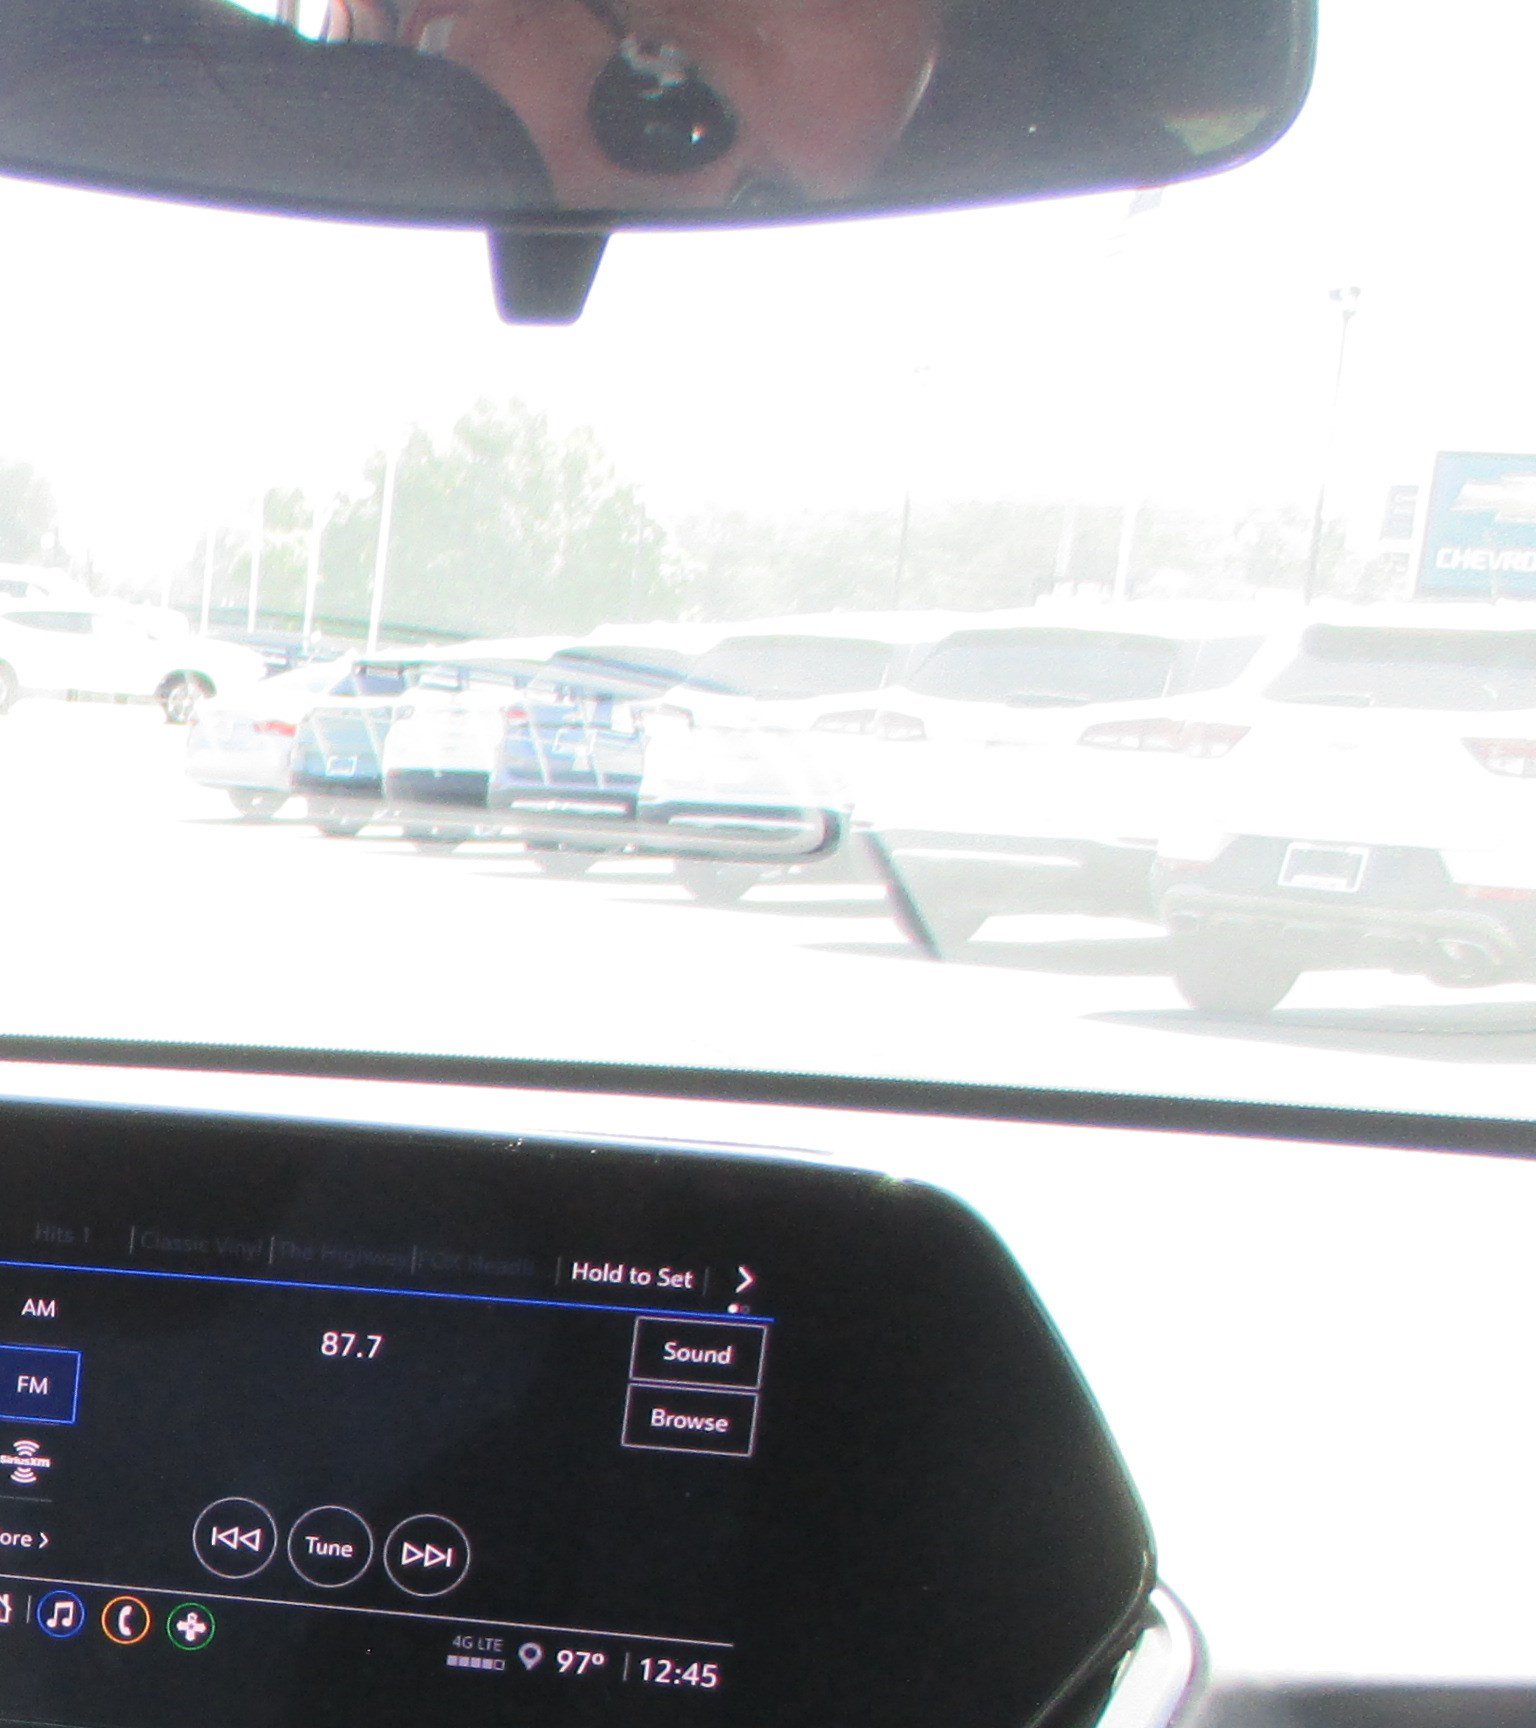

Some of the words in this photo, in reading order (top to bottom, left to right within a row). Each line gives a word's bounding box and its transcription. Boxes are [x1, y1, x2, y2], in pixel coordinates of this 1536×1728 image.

[571, 1261, 625, 1288] Hold
[631, 1266, 650, 1288] to
[656, 1265, 694, 1291] Set
[21, 1298, 57, 1319] AM
[321, 1332, 383, 1358] 87.7
[663, 1342, 732, 1366] Sound
[17, 1375, 49, 1396] FM
[650, 1409, 730, 1434] Browse
[305, 1537, 354, 1558] Tune
[452, 1635, 475, 1651] 4G
[479, 1636, 504, 1653] LTE
[639, 1658, 720, 1689] 12:45
